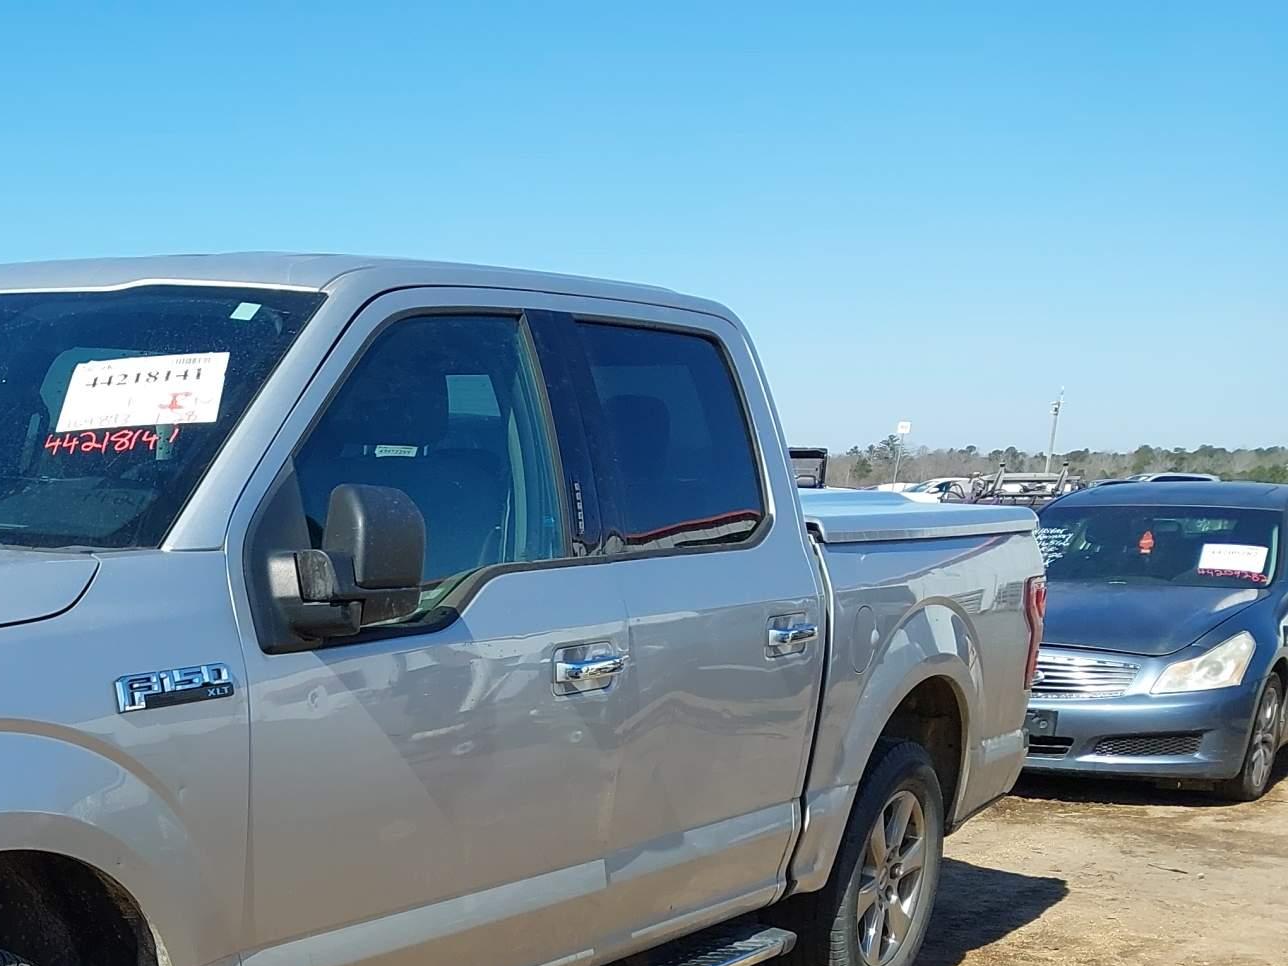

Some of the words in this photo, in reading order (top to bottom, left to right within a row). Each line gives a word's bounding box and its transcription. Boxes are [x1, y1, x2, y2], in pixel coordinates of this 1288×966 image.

[86, 367, 204, 388] 44218141
[44, 428, 179, 455] 44218141
[208, 686, 230, 697] XLT
